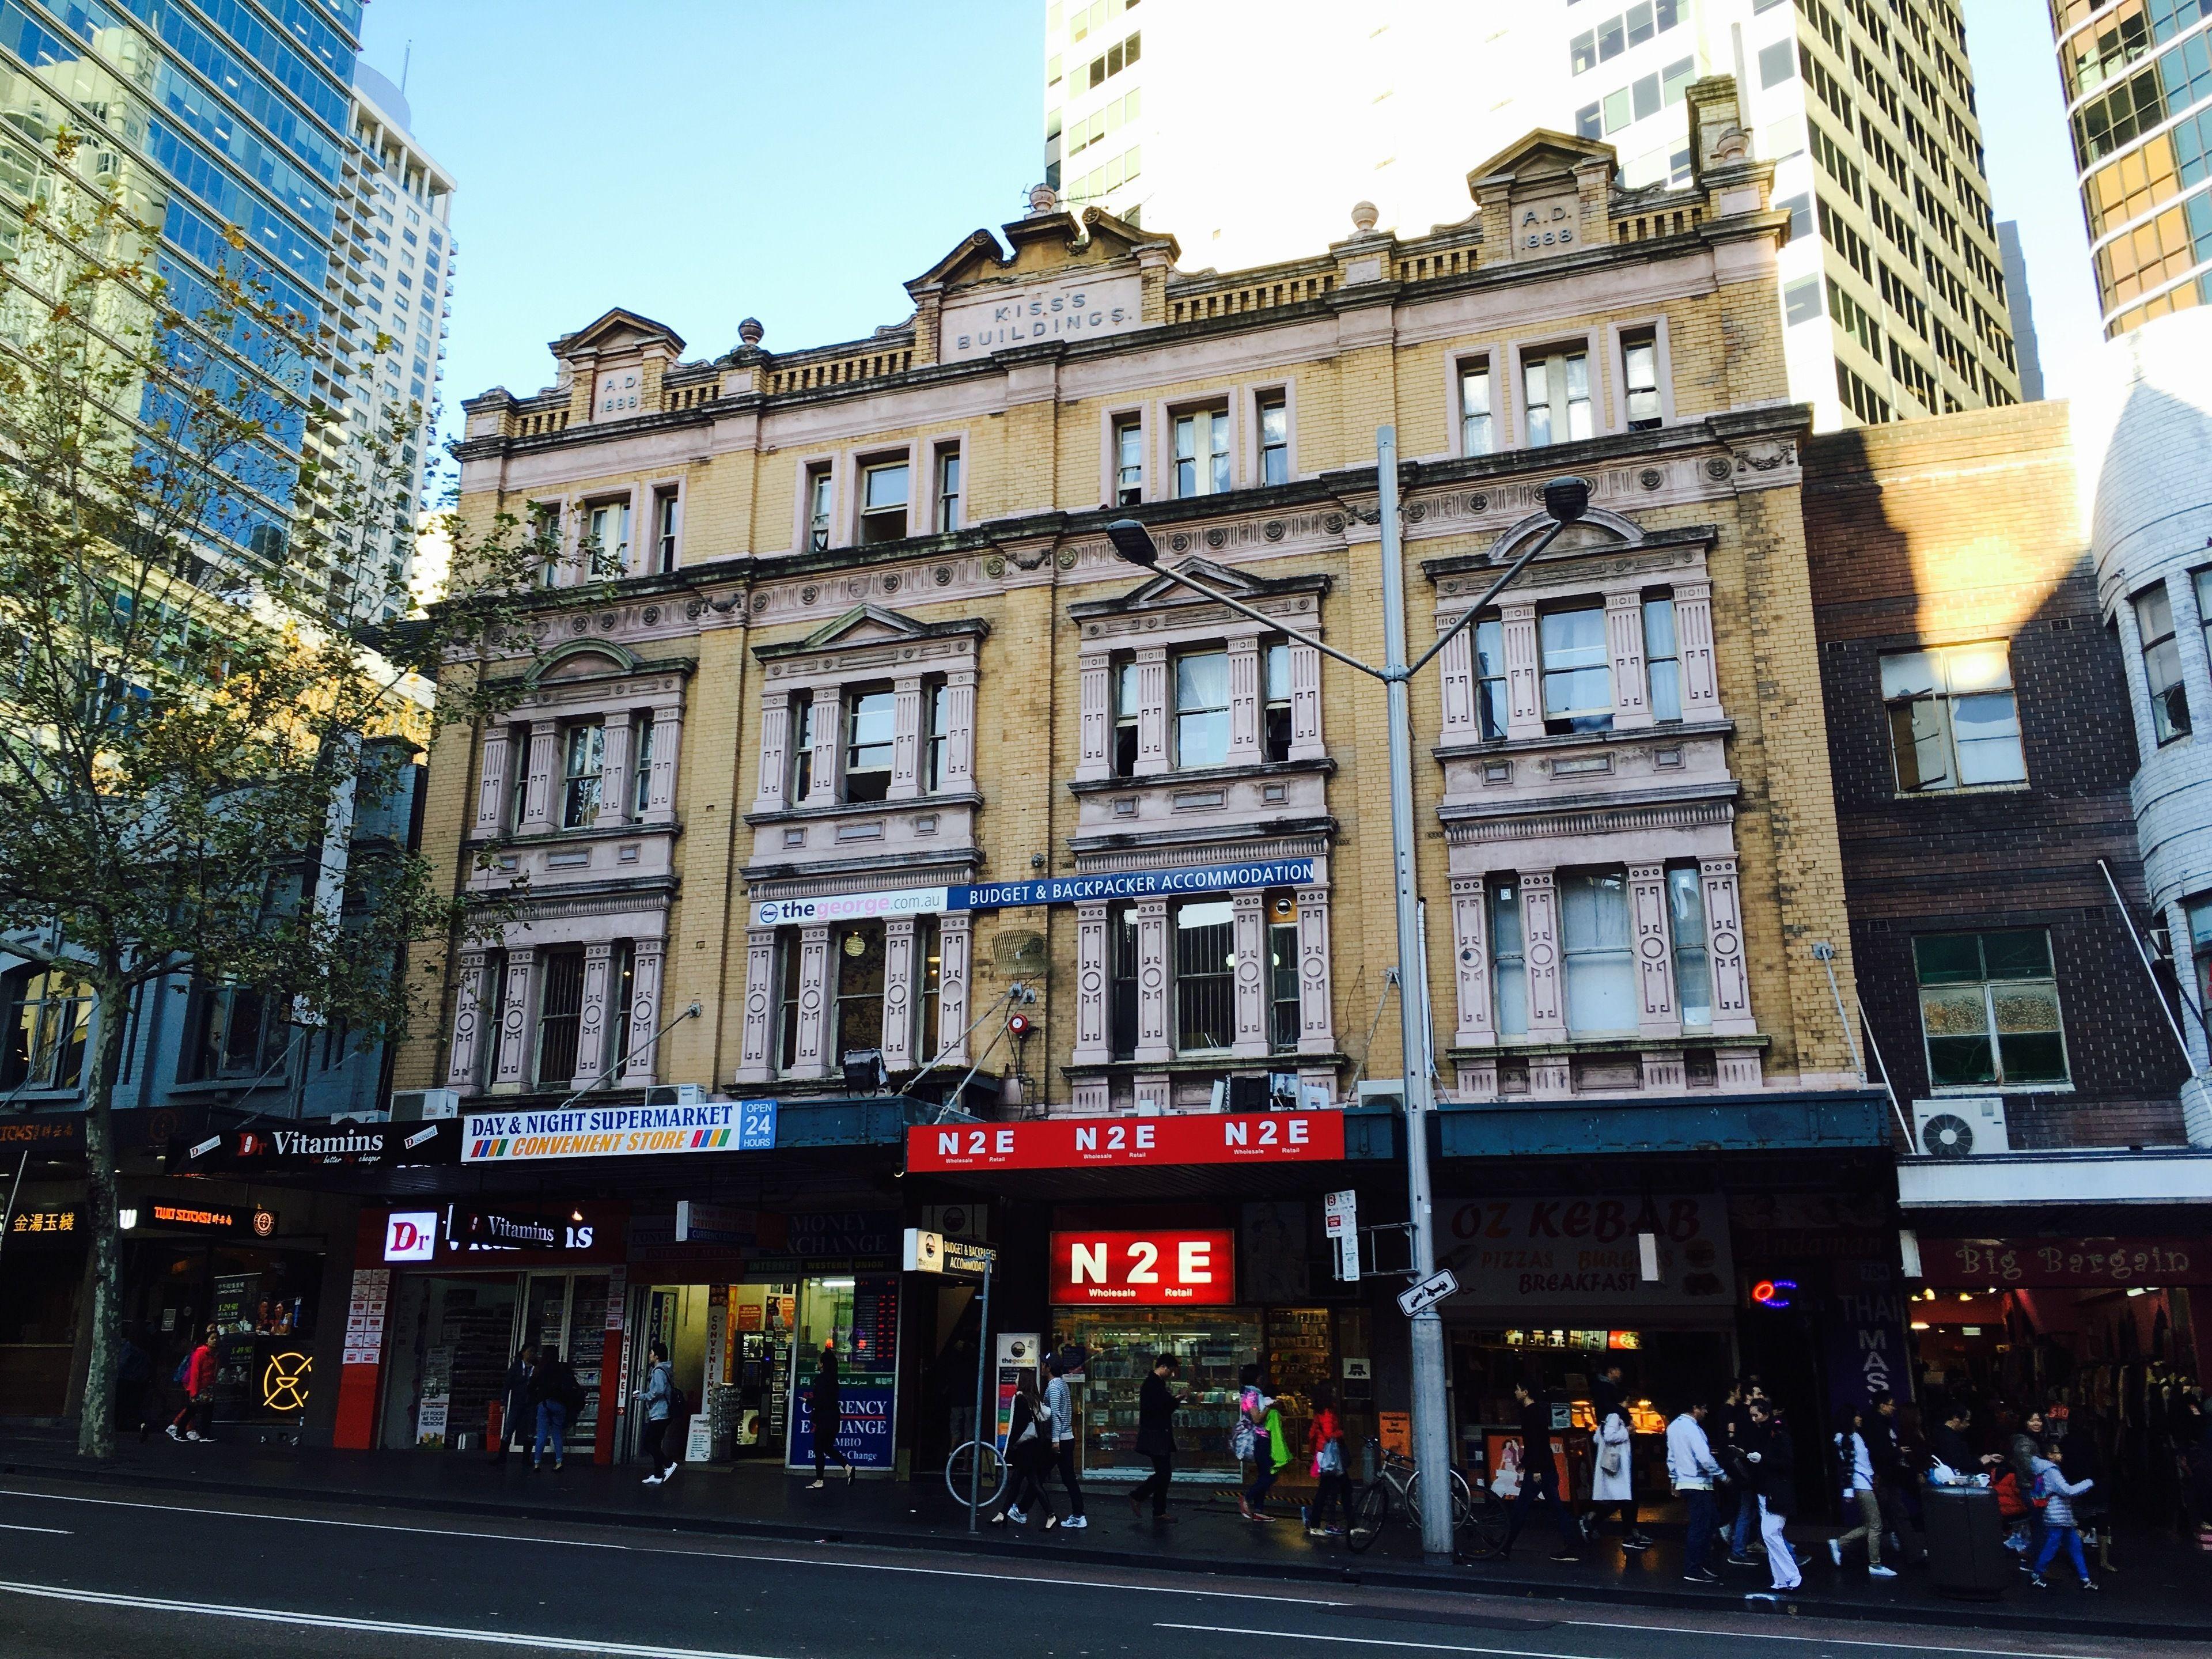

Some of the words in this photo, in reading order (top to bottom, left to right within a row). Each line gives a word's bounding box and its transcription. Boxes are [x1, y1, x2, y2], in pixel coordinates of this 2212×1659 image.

[1521, 229, 1572, 250] 1888
[995, 294, 1085, 322] KISS'S
[599, 396, 637, 412] 1888
[969, 886, 1029, 904] BUDGET
[1036, 885, 1046, 899] &
[1053, 877, 1155, 898] BACKPACKER
[1161, 863, 1313, 890] ACCOMMODATION
[782, 895, 940, 919] thegeorge.com.au
[747, 1103, 772, 1113] OPEN
[472, 1116, 506, 1136] DAY
[509, 1115, 521, 1134] &
[527, 1113, 585, 1134] NIGHT
[590, 1106, 732, 1130] SUPERMARKET
[745, 1116, 771, 1135] 24
[237, 1132, 267, 1156] Dr
[272, 1129, 383, 1154] Vitamins
[406, 1128, 436, 1147] Discount
[512, 1134, 624, 1156] CONVENIENT
[627, 1130, 688, 1151] STORE
[744, 1137, 771, 1147] HOURS
[323, 1155, 342, 1164] better
[358, 1154, 381, 1165] cheaper
[154, 1207, 175, 1219] TWO
[791, 1214, 866, 1232] MONEY
[1451, 1203, 1511, 1239] OZ
[391, 1222, 429, 1251] Dr
[488, 1215, 554, 1241] Vitamins
[945, 1241, 963, 1253] BUDGET
[964, 1244, 968, 1256] &
[806, 1262, 848, 1270] WESTERN
[1482, 1250, 1553, 1268] PIZZAS
[1578, 1249, 1673, 1272] BURGS
[1956, 1245, 2022, 1280] Big
[2037, 1246, 2190, 1279] Bargain
[1089, 1289, 1136, 1297] Wholesale
[1165, 1288, 1192, 1297] Retail
[1519, 1273, 1638, 1294] BREAKFAST
[1838, 1295, 1900, 1323] THAI
[620, 1325, 630, 1399] INTERNET
[1857, 1329, 1890, 1403] MAS
[802, 1400, 887, 1414] CRENCY
[801, 1421, 887, 1434] EANGE
[834, 1438, 861, 1446] MBIO
[847, 1450, 878, 1461] Change
